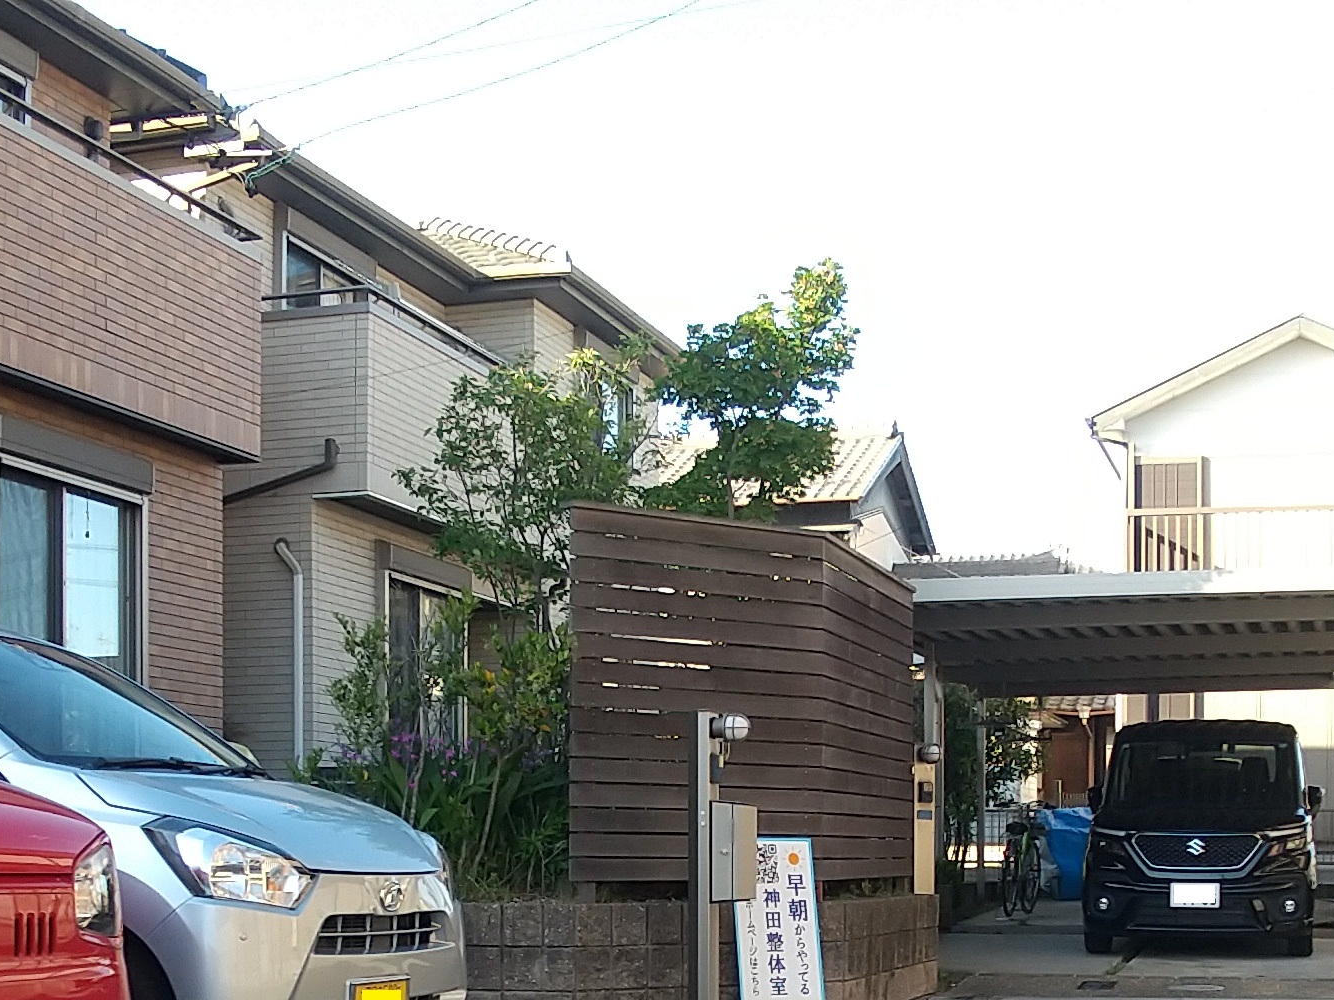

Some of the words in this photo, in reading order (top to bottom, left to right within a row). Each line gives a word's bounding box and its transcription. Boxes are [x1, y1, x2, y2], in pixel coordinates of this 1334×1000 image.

[762, 888, 789, 996] 神田整体室
[786, 873, 811, 995] 早朝からやってる
